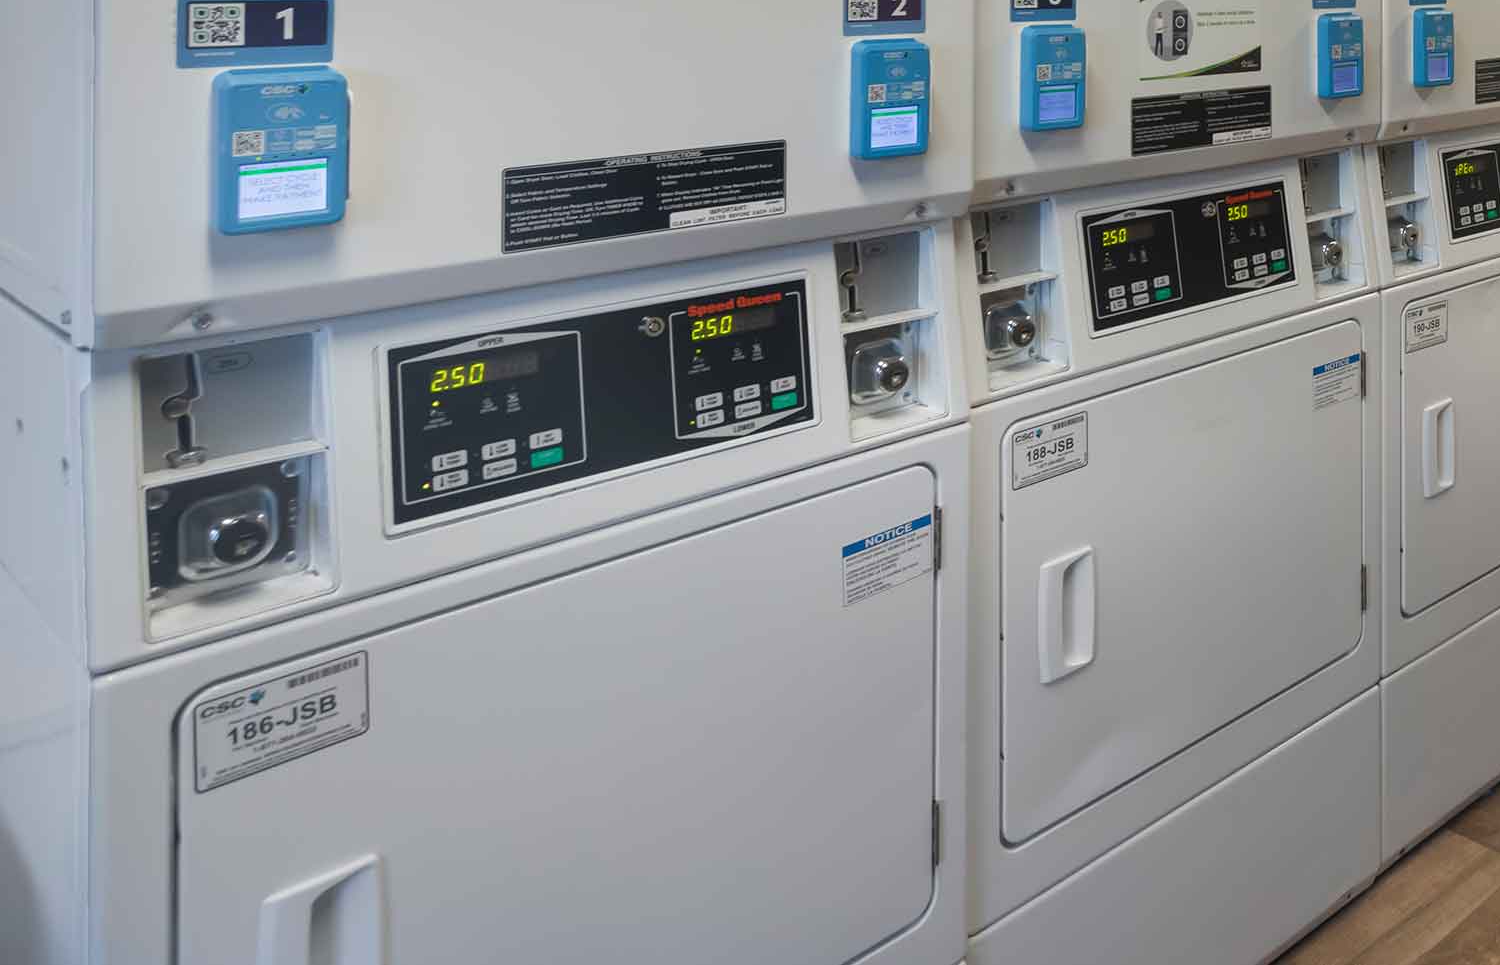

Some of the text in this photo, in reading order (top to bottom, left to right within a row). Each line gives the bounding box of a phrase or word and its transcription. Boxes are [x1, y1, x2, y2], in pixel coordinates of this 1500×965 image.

[275, 7, 295, 40] 1
[688, 292, 782, 317] Speed Queen
[691, 315, 733, 340] 2.50
[1414, 318, 1441, 334] 190-JSB
[431, 362, 485, 392] 2.50
[1026, 437, 1074, 462] 188-JSB
[864, 523, 913, 548] NOTICE
[201, 696, 246, 719] CSC
[227, 694, 337, 745] 186-JSB
